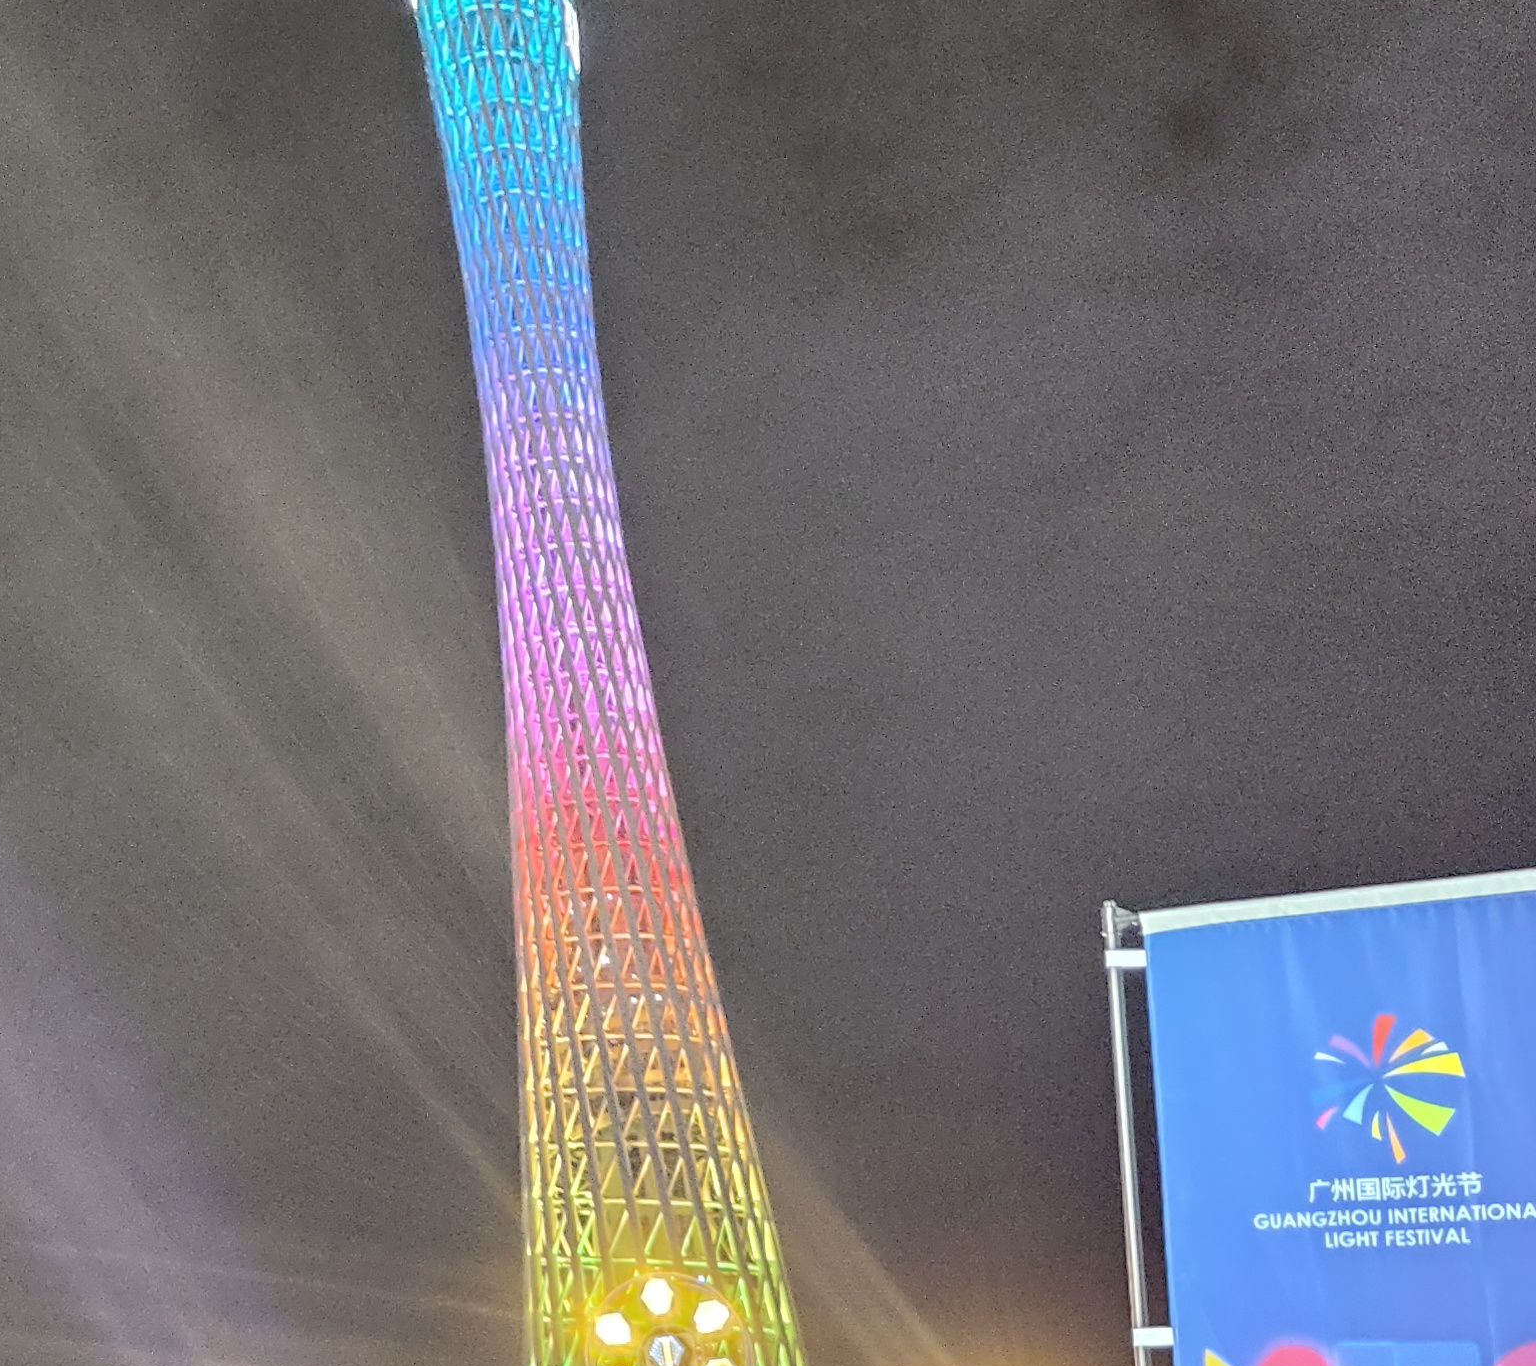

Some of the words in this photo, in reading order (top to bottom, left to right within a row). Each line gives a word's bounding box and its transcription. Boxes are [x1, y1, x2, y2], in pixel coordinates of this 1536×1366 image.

[1309, 1172, 1483, 1203] 广州国际灯光节
[1253, 1209, 1382, 1230] GUANGZHOU
[1388, 1202, 1536, 1225] INTERNATIONA
[1324, 1231, 1379, 1248] LIGHT
[1385, 1227, 1471, 1247] FESTIVAL
